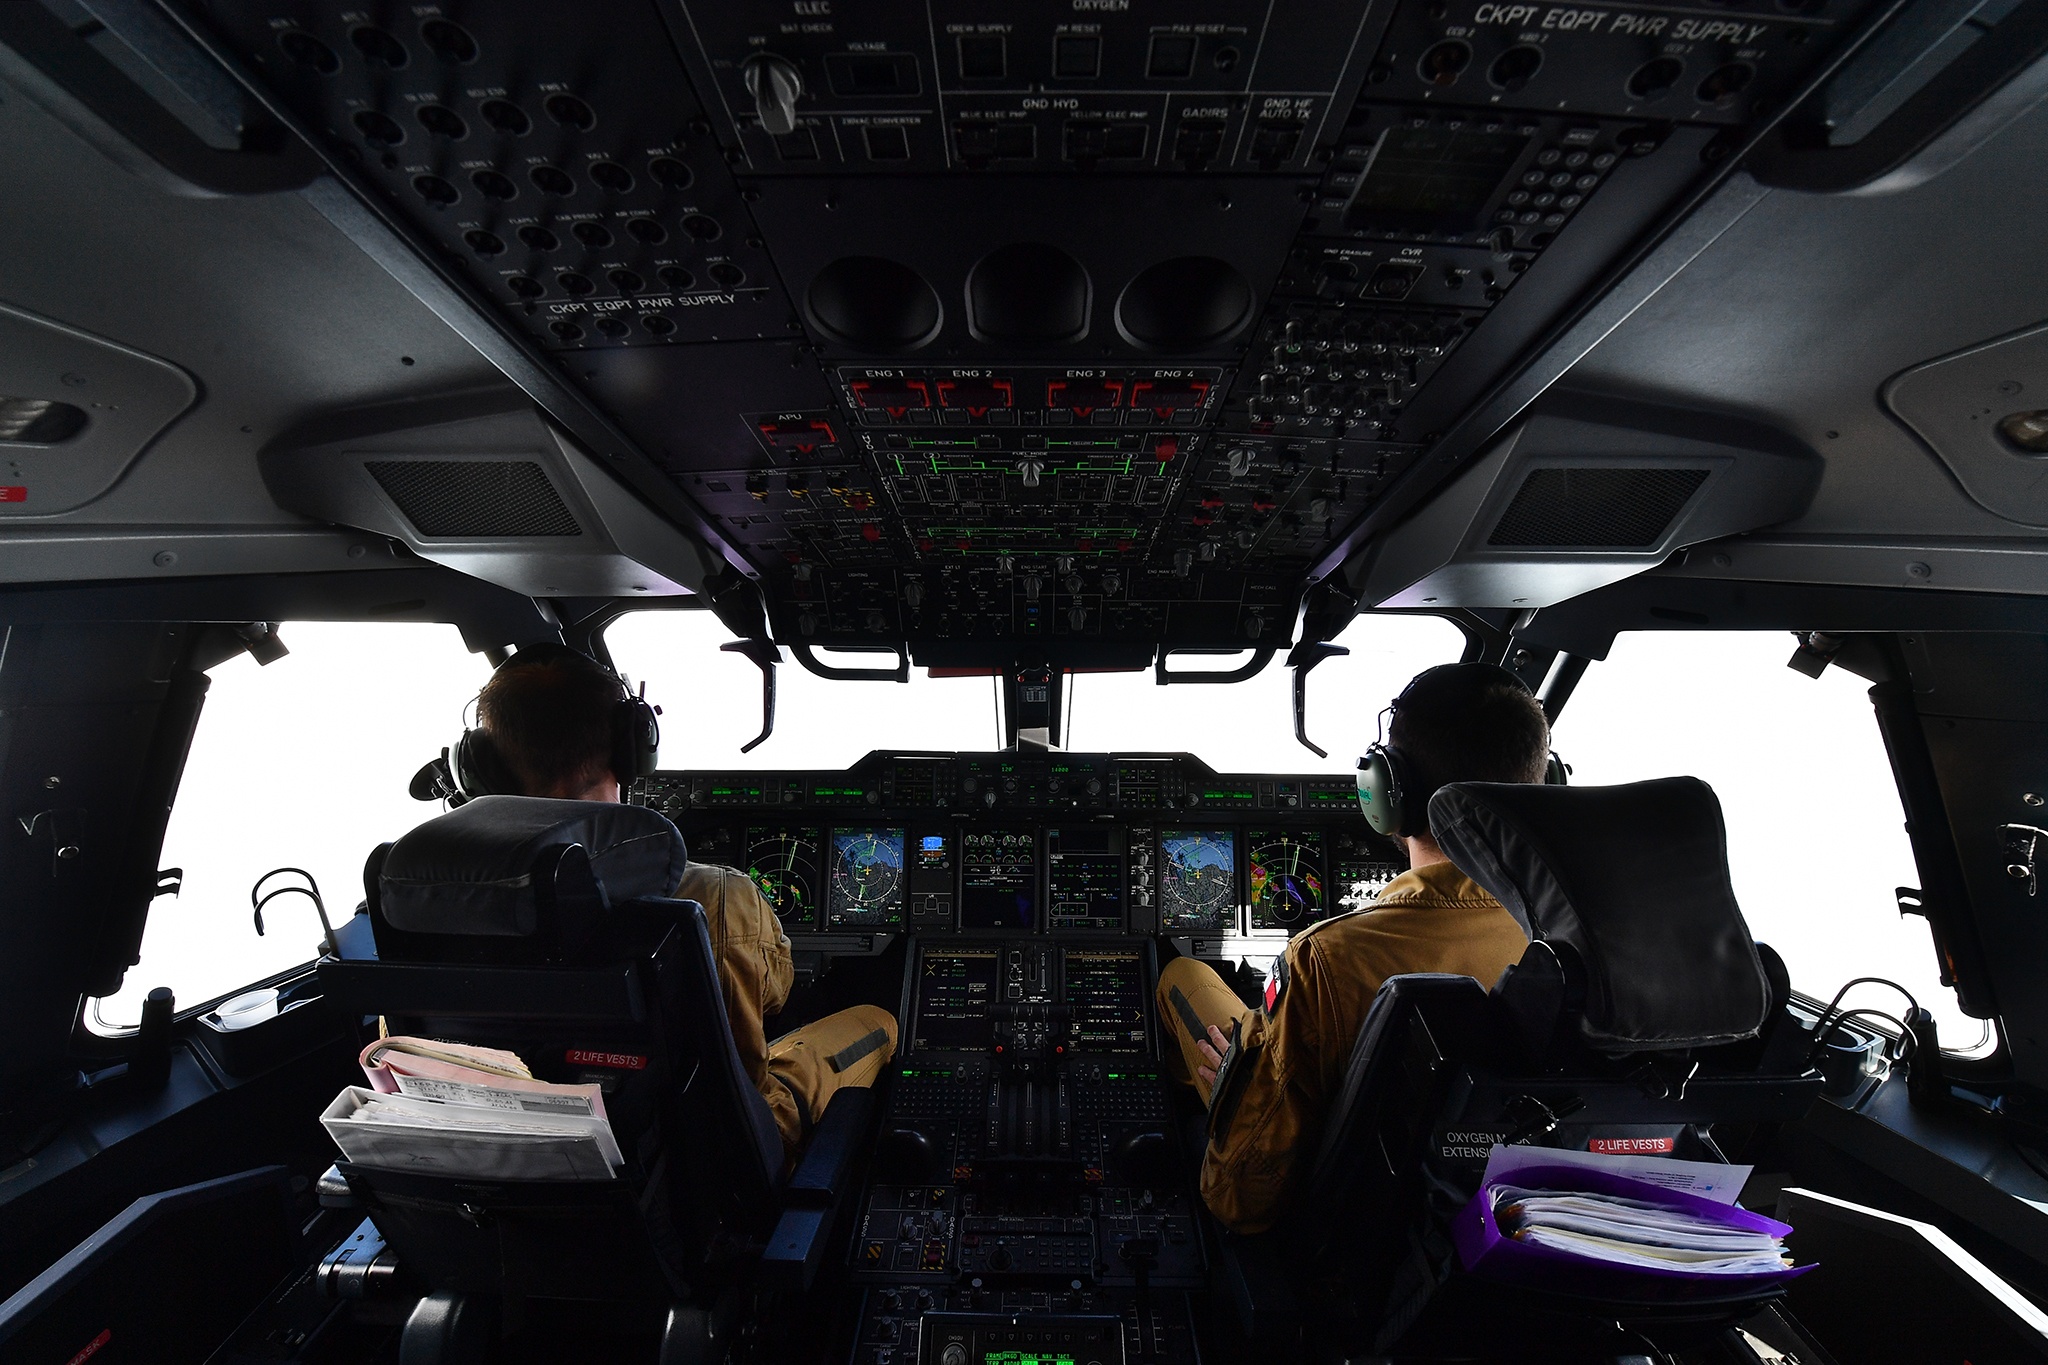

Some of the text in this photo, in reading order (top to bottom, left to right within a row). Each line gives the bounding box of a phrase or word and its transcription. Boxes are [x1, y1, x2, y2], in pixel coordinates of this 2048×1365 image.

[794, 1, 831, 15] ELEC
[1073, 0, 1129, 10] OXYGEN
[801, 24, 834, 34] CHECK
[977, 24, 1013, 34] SUPPLY
[1071, 24, 1102, 33] RESET
[1194, 24, 1226, 33] RESET
[1474, 3, 1769, 45] CKPT EQPT PWR SUPPLY
[847, 41, 887, 51] VOLTAGE
[1022, 98, 1079, 109] GND HYD
[1263, 98, 1314, 109] GND HF
[960, 110, 982, 120] BLUE
[984, 111, 1006, 120] ELEC
[1106, 111, 1130, 120] ELEC
[1258, 109, 1313, 120] AUTO TX
[1400, 248, 1424, 257] CVR
[549, 294, 737, 315] CKPT EQPT PWR SUPPLY
[865, 369, 905, 378] ENG 1
[952, 369, 993, 378] ENG 2
[1066, 369, 1107, 378] ENG 3
[1154, 369, 1195, 378] ENG 4
[1203, 384, 1220, 410] FIRE
[778, 413, 802, 421] APU
[573, 1051, 639, 1066] 2 LIFE VESTS
[1447, 1132, 1494, 1144] OXYGEN
[1597, 1138, 1666, 1151] 2 LIFE VESTS
[861, 1215, 871, 1238] DASS
[947, 1217, 956, 1239] DASS
